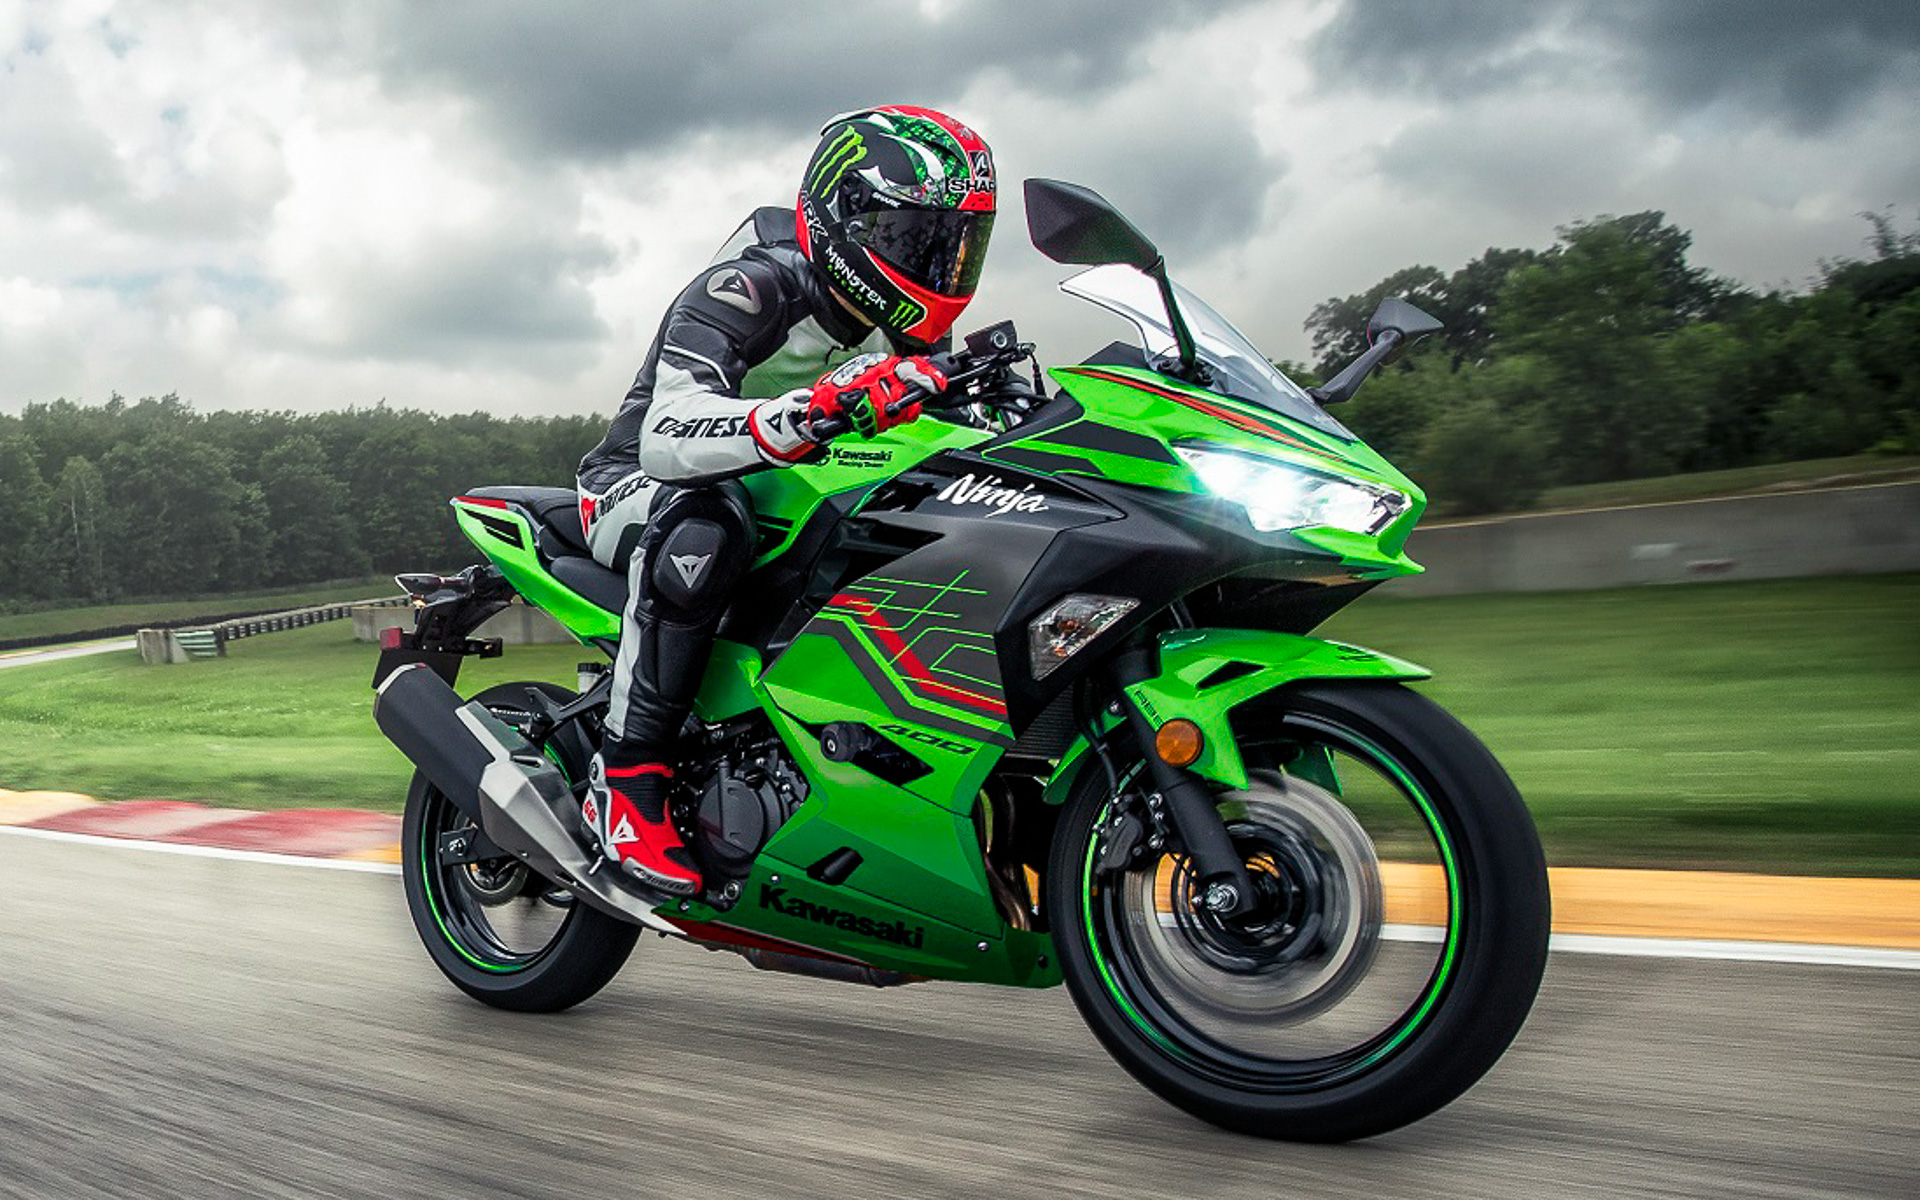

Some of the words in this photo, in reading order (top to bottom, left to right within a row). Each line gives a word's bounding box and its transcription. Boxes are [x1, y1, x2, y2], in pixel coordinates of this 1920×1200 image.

[826, 244, 888, 311] MONSTER
[833, 448, 893, 462] Kawasaki
[936, 473, 1050, 519] Ninja
[878, 724, 976, 754] 400
[759, 883, 925, 949] Kawasaki
